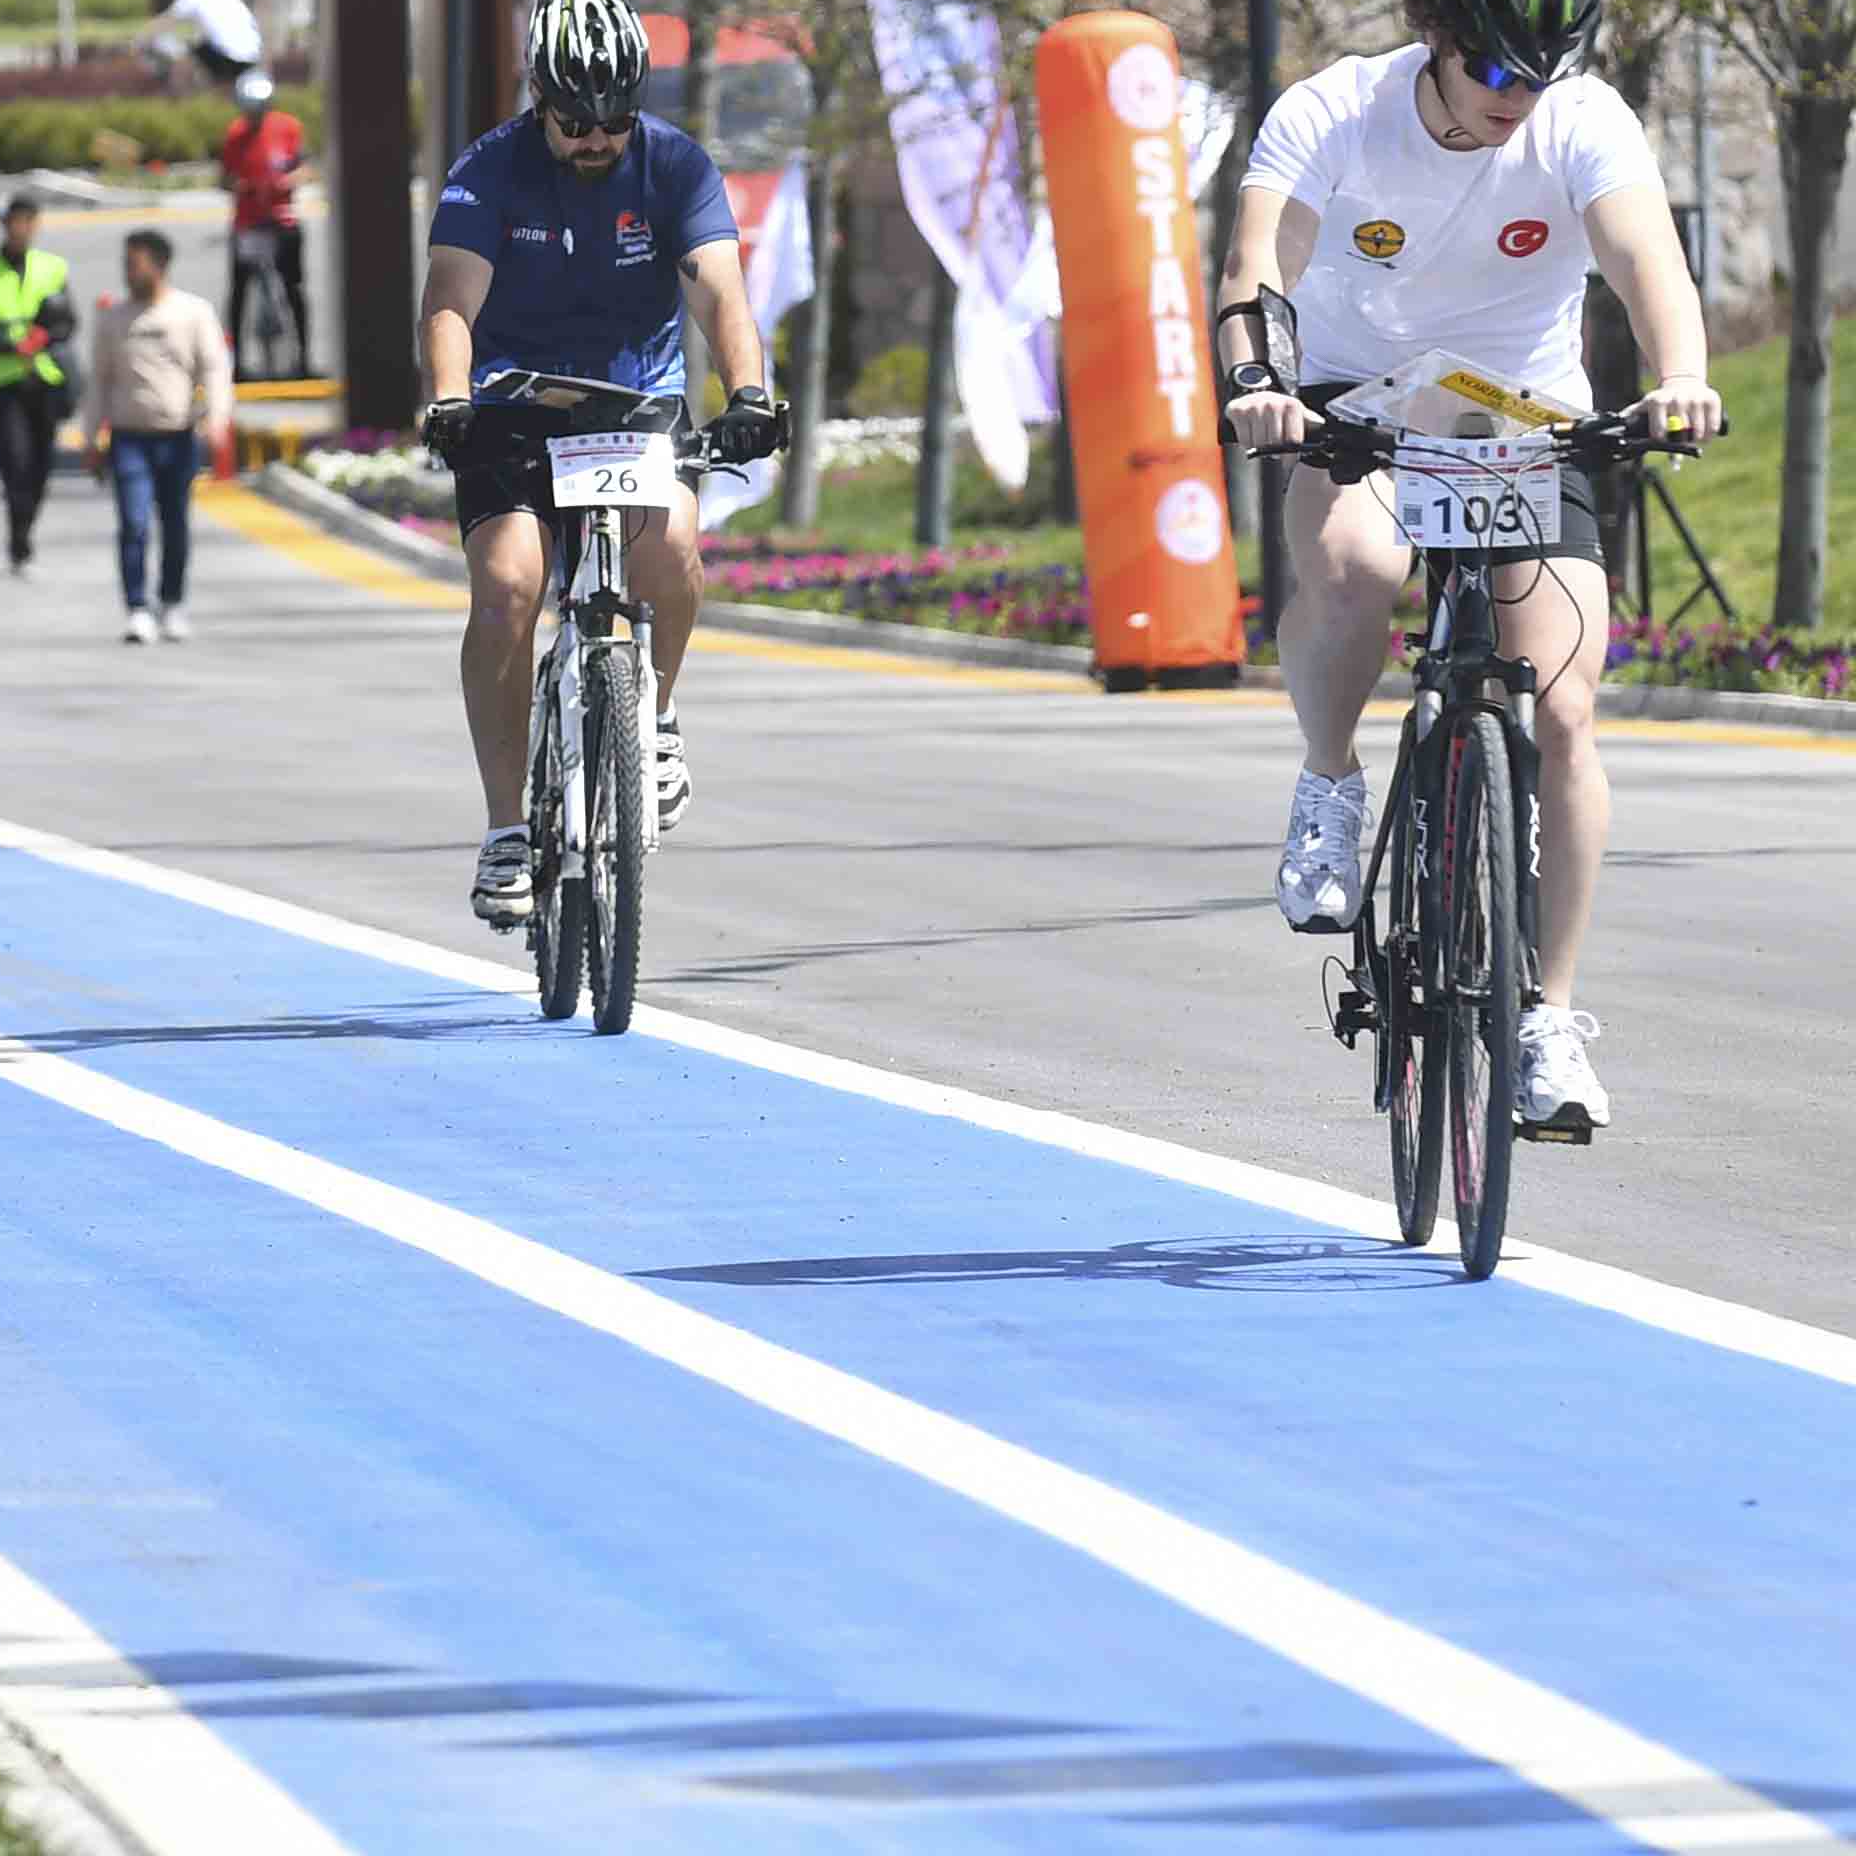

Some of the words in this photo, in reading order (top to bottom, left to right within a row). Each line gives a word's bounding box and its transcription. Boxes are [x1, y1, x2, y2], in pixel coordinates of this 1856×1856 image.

[1131, 138, 1196, 438] START
[594, 469, 638, 493] 26
[1432, 495, 1523, 535] 103
